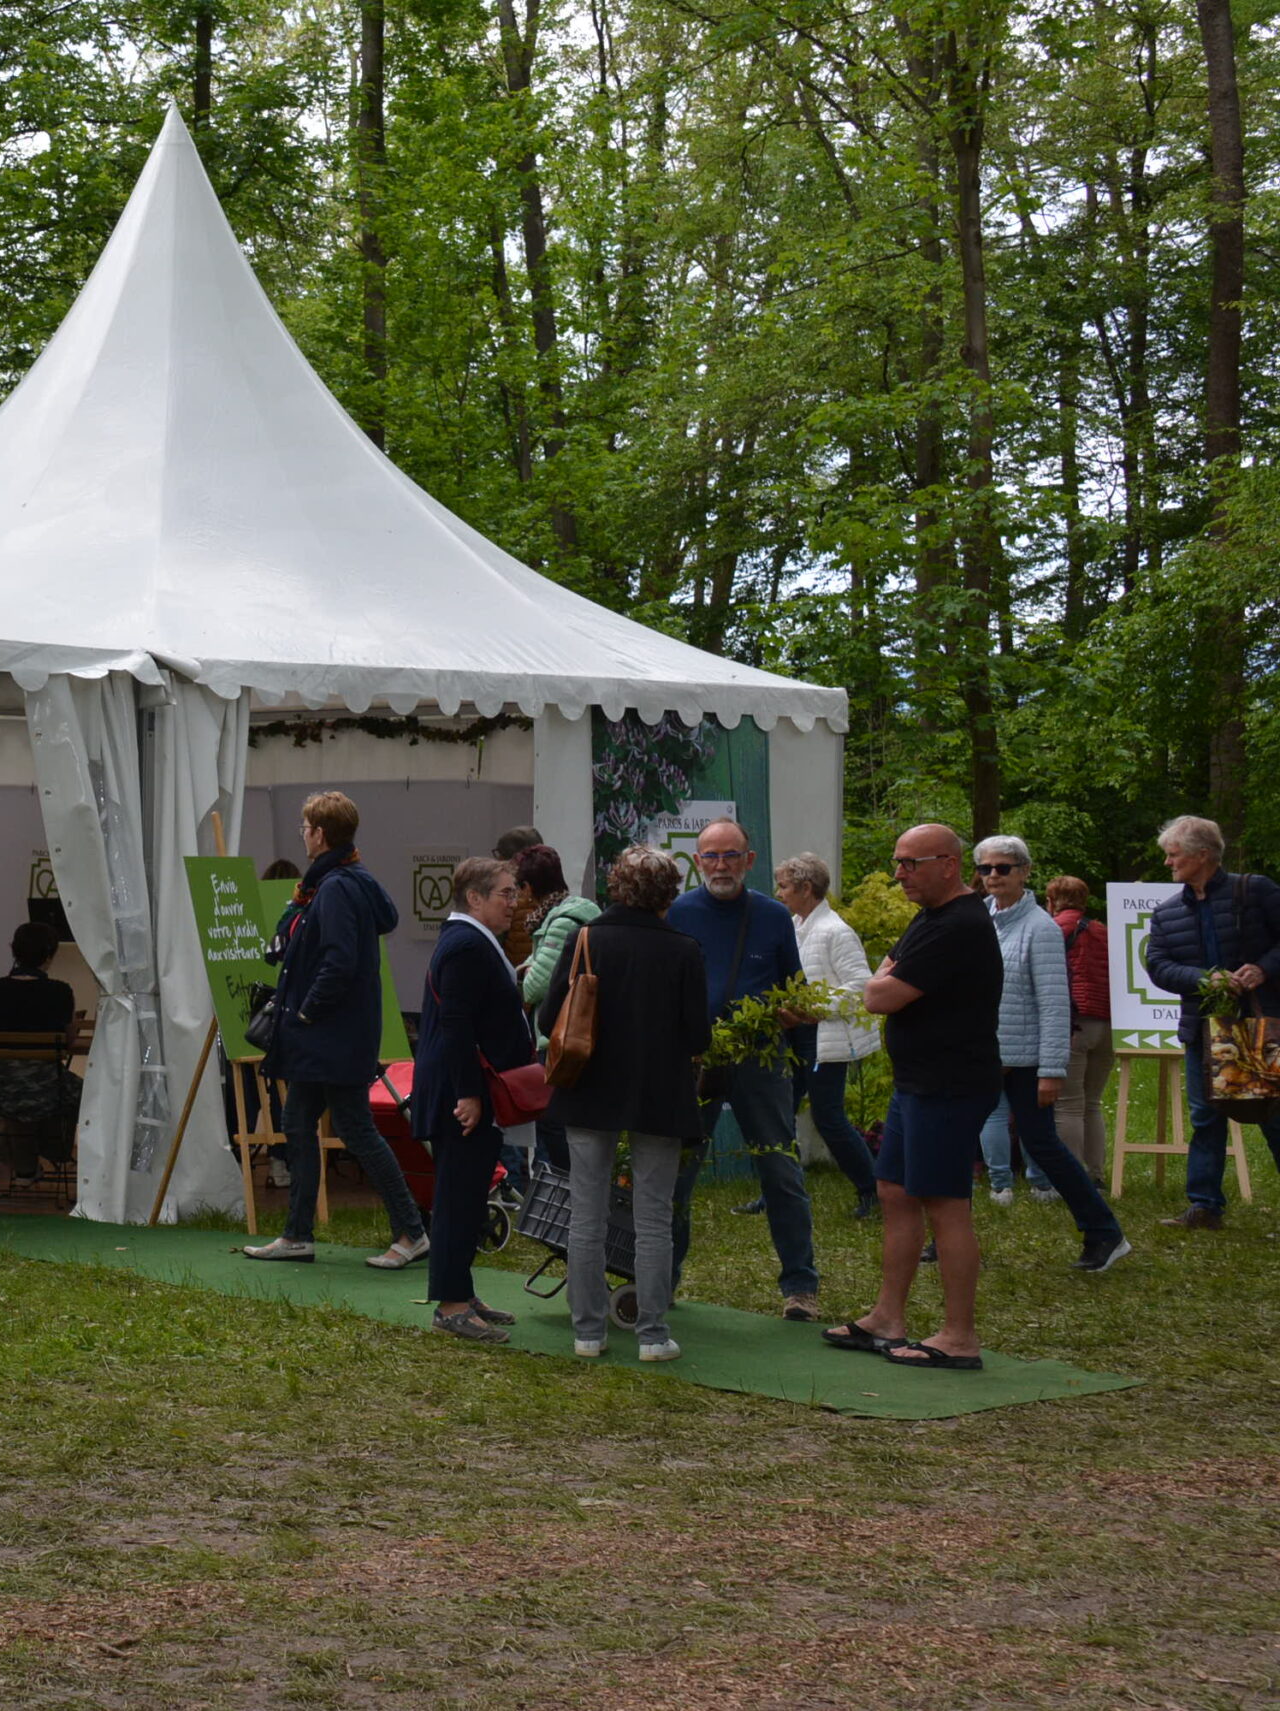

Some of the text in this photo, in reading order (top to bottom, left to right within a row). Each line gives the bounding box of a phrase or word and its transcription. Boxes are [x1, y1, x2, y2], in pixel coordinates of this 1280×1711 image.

[657, 817, 710, 831] PARCS & JARD
[210, 873, 238, 894] Envie
[1123, 898, 1162, 910] PARCS
[207, 917, 259, 944] votre jardin
[1153, 1008, 1180, 1020] D'AL
